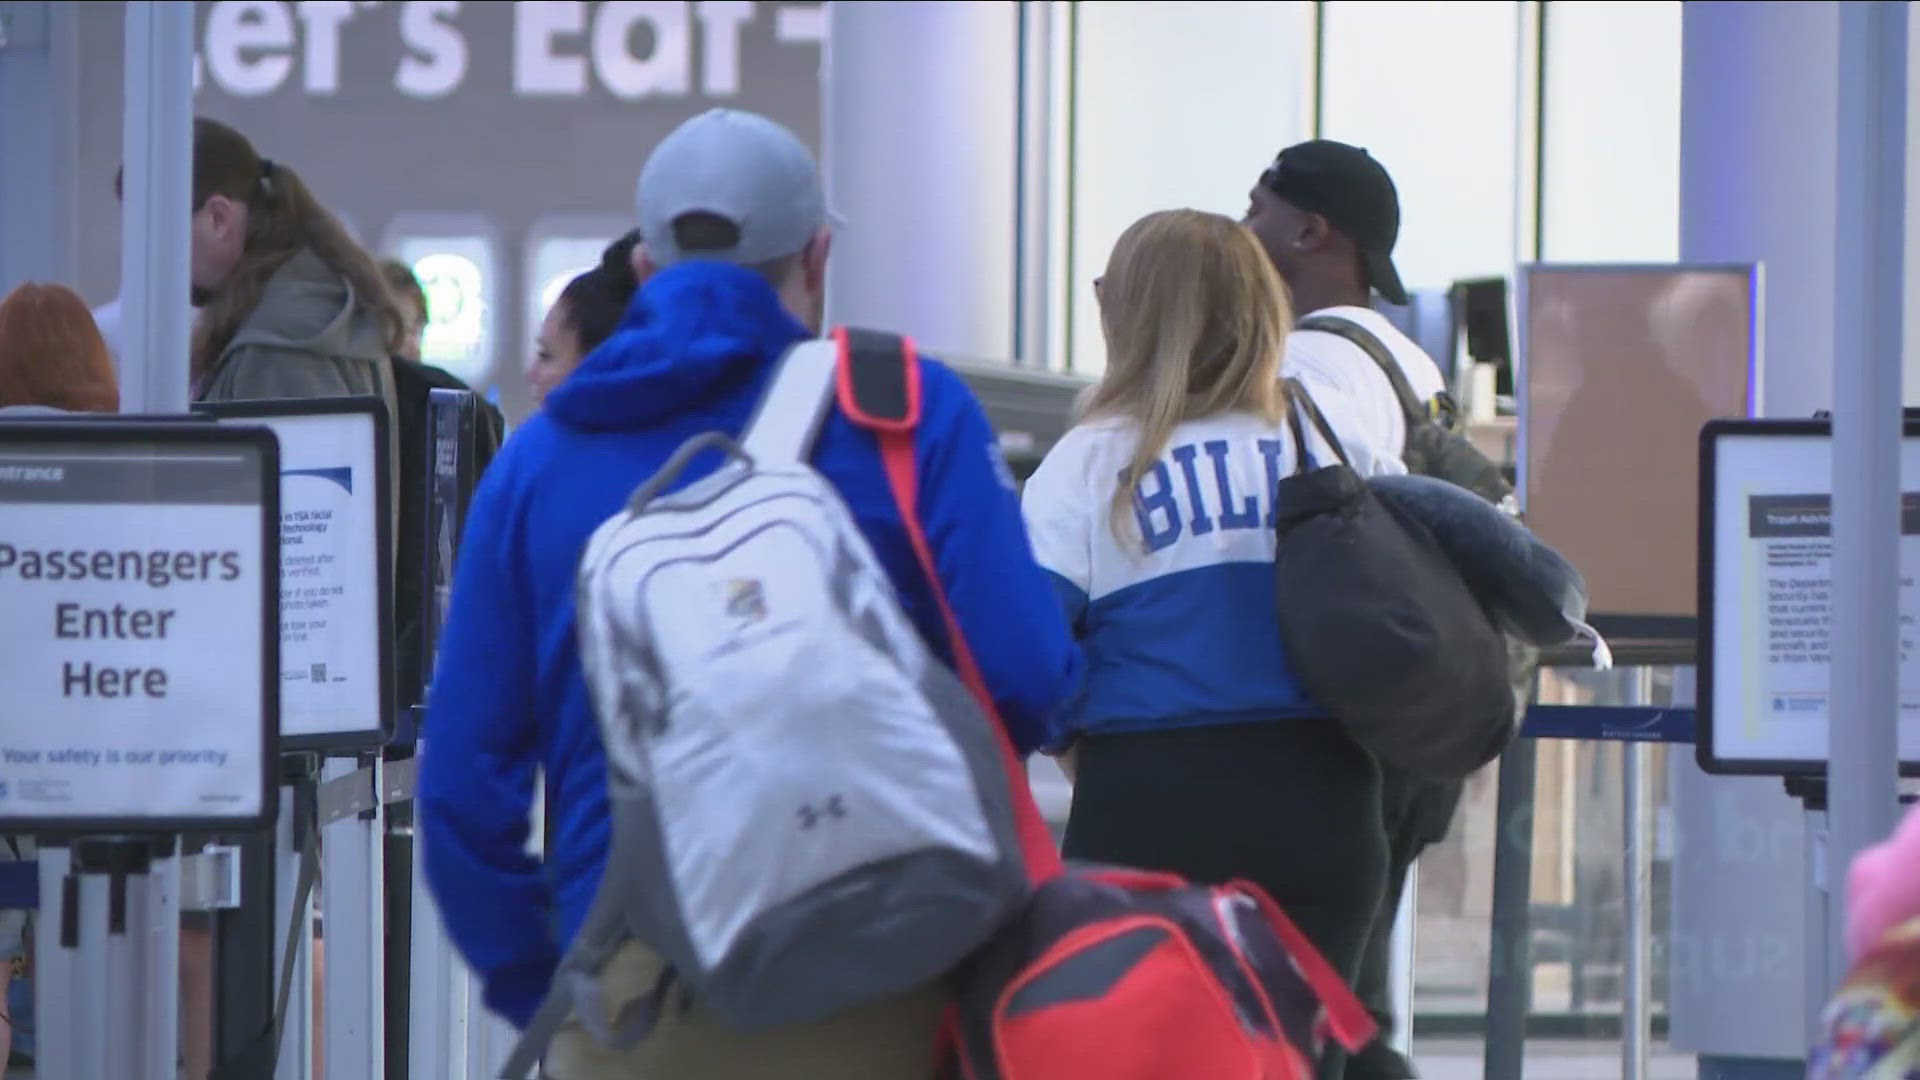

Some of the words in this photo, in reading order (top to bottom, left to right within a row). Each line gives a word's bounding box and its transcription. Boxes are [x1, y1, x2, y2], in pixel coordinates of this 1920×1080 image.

[512, 0, 756, 98] Eat
[0, 543, 240, 587] Passengers
[1769, 579, 1787, 589] The
[1769, 591, 1808, 602] Security
[55, 602, 175, 640] Enter
[62, 661, 167, 698] Here
[3, 748, 41, 764] Your
[47, 747, 101, 767] safety
[105, 748, 120, 764] is
[124, 750, 154, 764] our
[158, 748, 228, 767] priority
